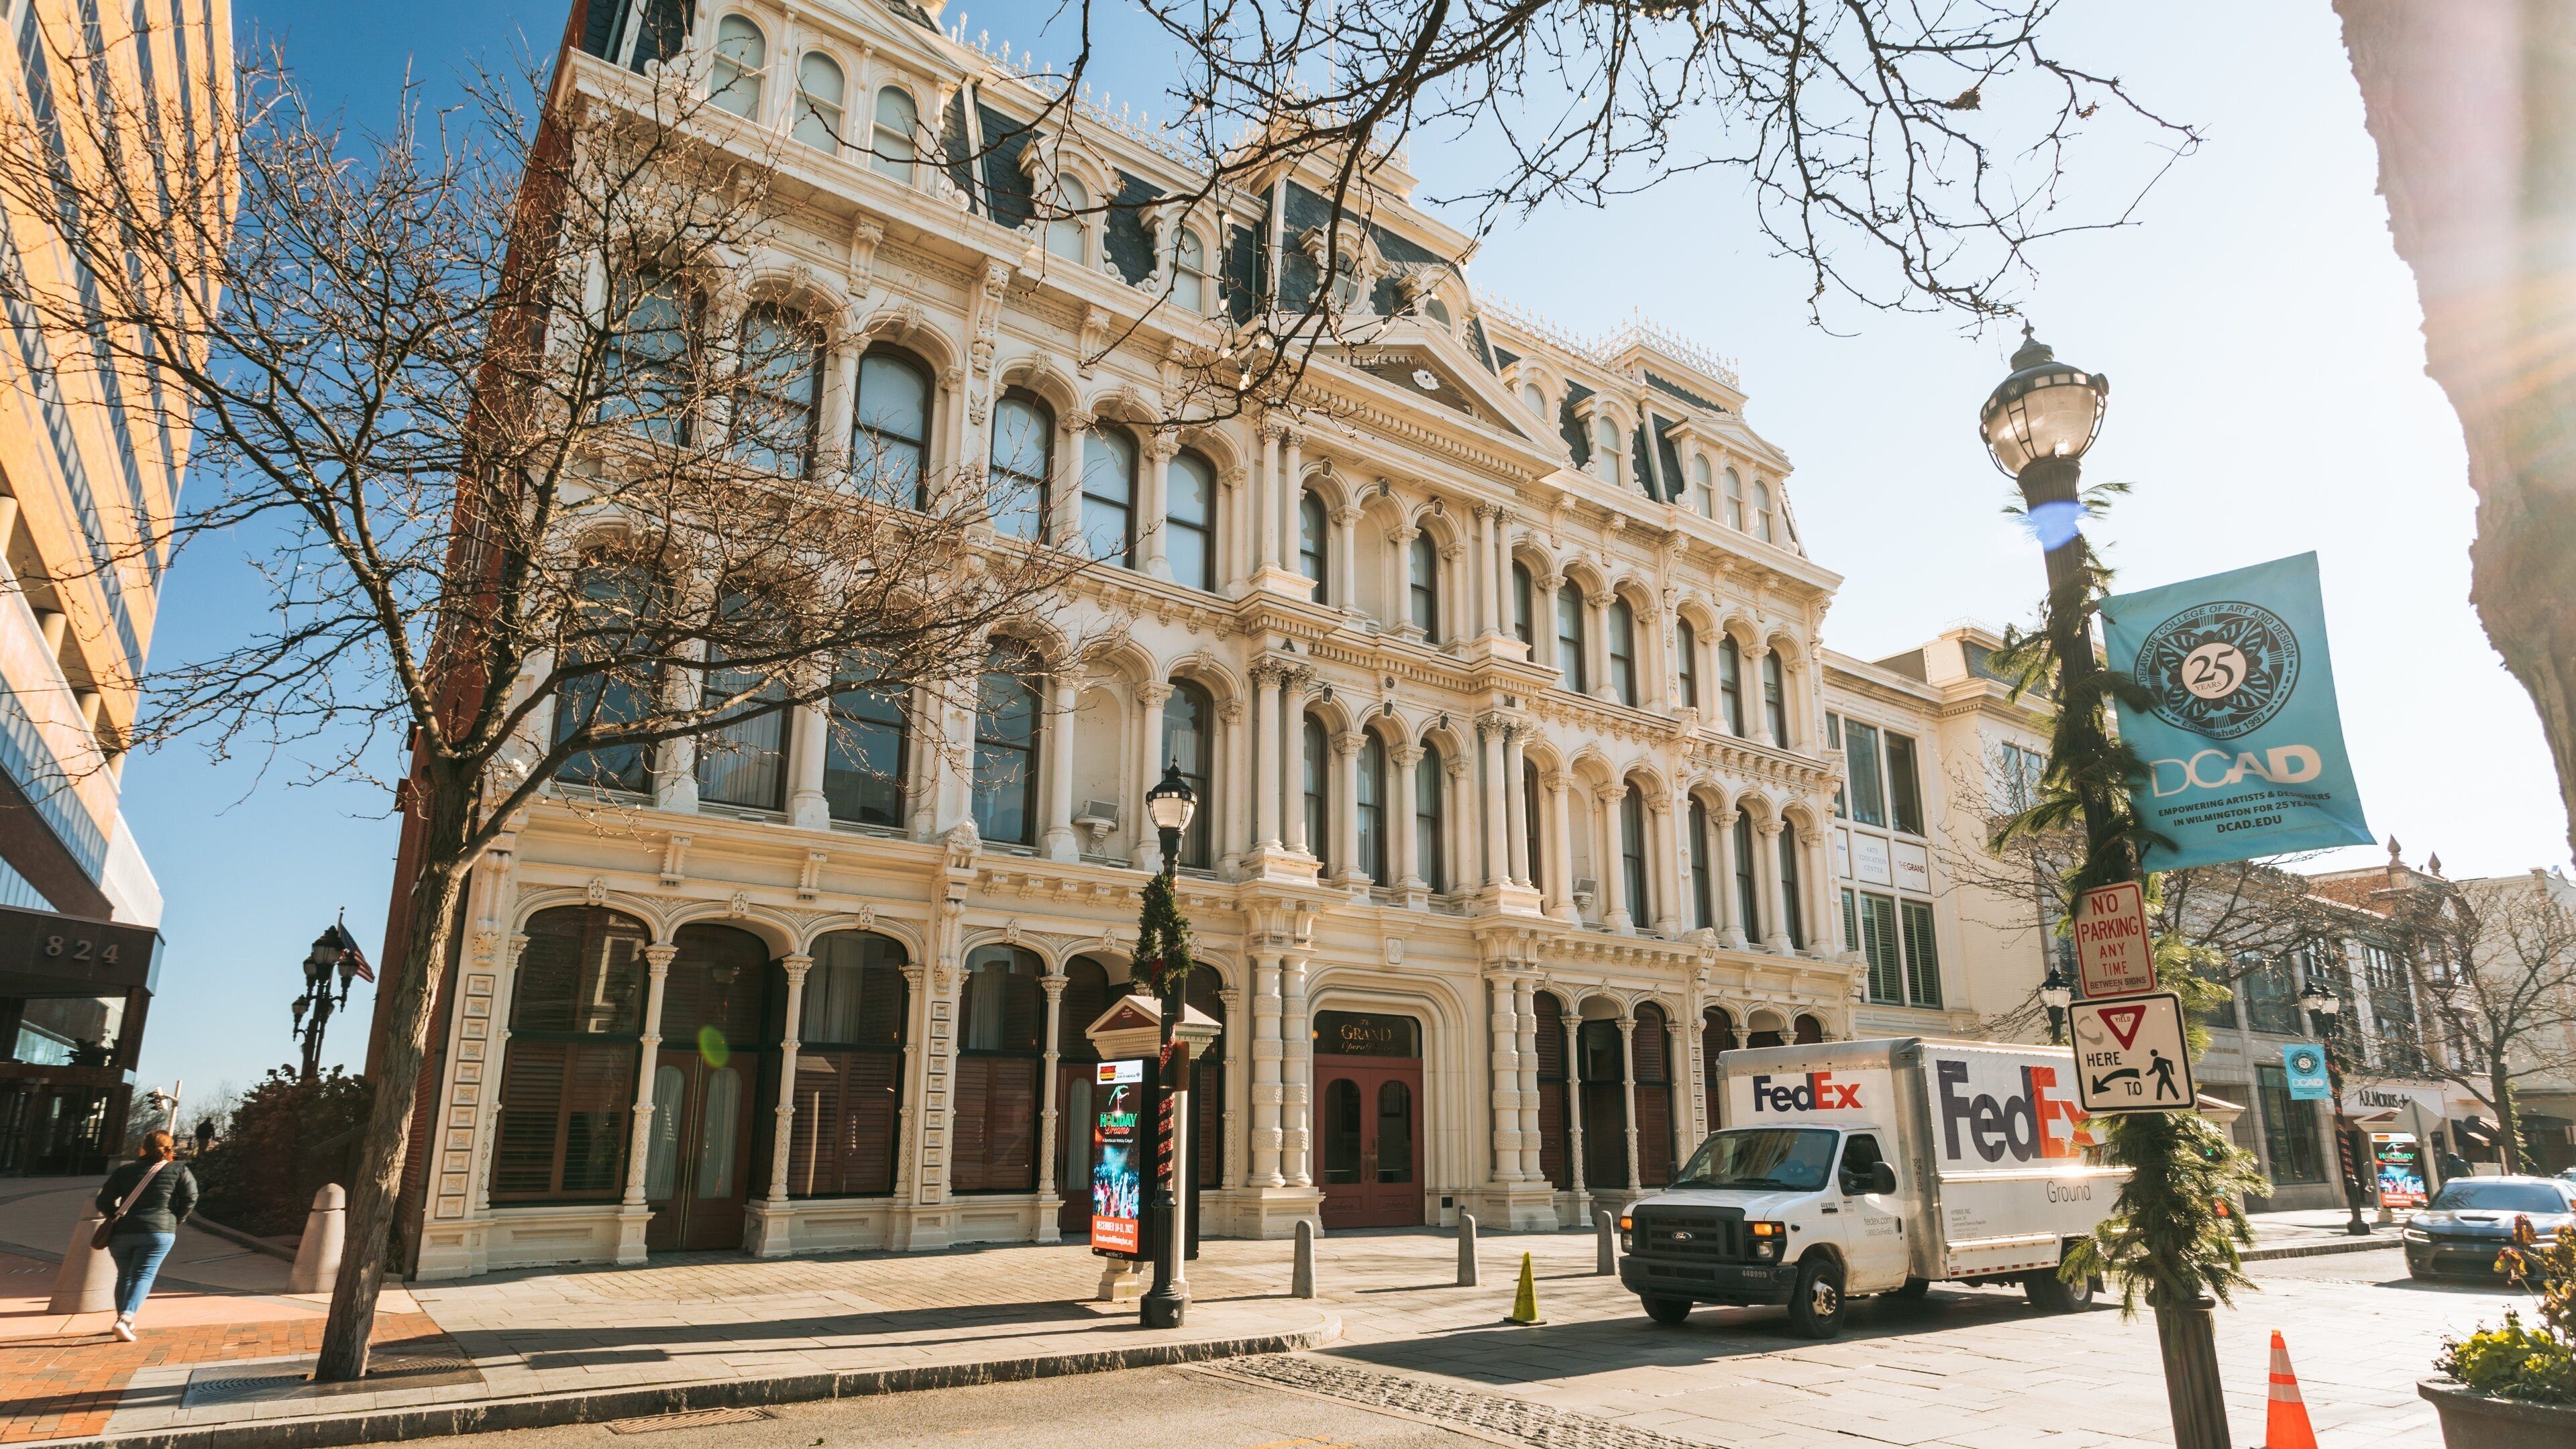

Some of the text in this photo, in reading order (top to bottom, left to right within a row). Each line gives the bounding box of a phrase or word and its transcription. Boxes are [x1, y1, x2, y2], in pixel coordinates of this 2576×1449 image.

[1281, 638, 1295, 652] A
[2138, 604, 2295, 682] DELAWARE COLLEGE OF ART AND DESIGN
[2189, 647, 2235, 693] 25
[2194, 680, 2222, 692] YEARS
[2182, 712, 2266, 737] Established 1997
[2149, 745, 2322, 798] DCAD
[2158, 799, 2224, 817] EMPOWERING
[2226, 792, 2265, 806] ARTISTS
[2277, 790, 2331, 800] DESIGNERS
[2174, 818, 2185, 826] IN
[2186, 807, 2251, 824] WILMINGTON
[2253, 804, 2273, 814] FOR
[2216, 814, 2282, 834] DCAD.EDU
[1866, 847, 1878, 855] ARTS
[1858, 854, 1886, 865] EDUCATION
[1864, 865, 1883, 874] CENTER
[2091, 894, 2118, 916] NO
[2080, 916, 2139, 943] PARKING
[45, 936, 119, 964] 824
[2100, 943, 2125, 959] ANY
[2102, 961, 2129, 977] TIME
[2090, 976, 2147, 989] BETWEEN SIGNS
[1342, 1041, 1365, 1053] Opera
[2086, 1052, 2122, 1067] HERE
[2125, 1081, 2143, 1095] TO
[2292, 1078, 2324, 1087] DCAD
[1753, 1071, 1864, 1112] FedEx
[2371, 1091, 2398, 1108] MORRIS
[1099, 1114, 1138, 1127] HOLIDAY
[2047, 1180, 2091, 1203] Ground
[1096, 1220, 1114, 1231] DECEMBER
[1864, 1216, 1893, 1226] fedex.com
[1741, 1270, 1767, 1278] 448999
